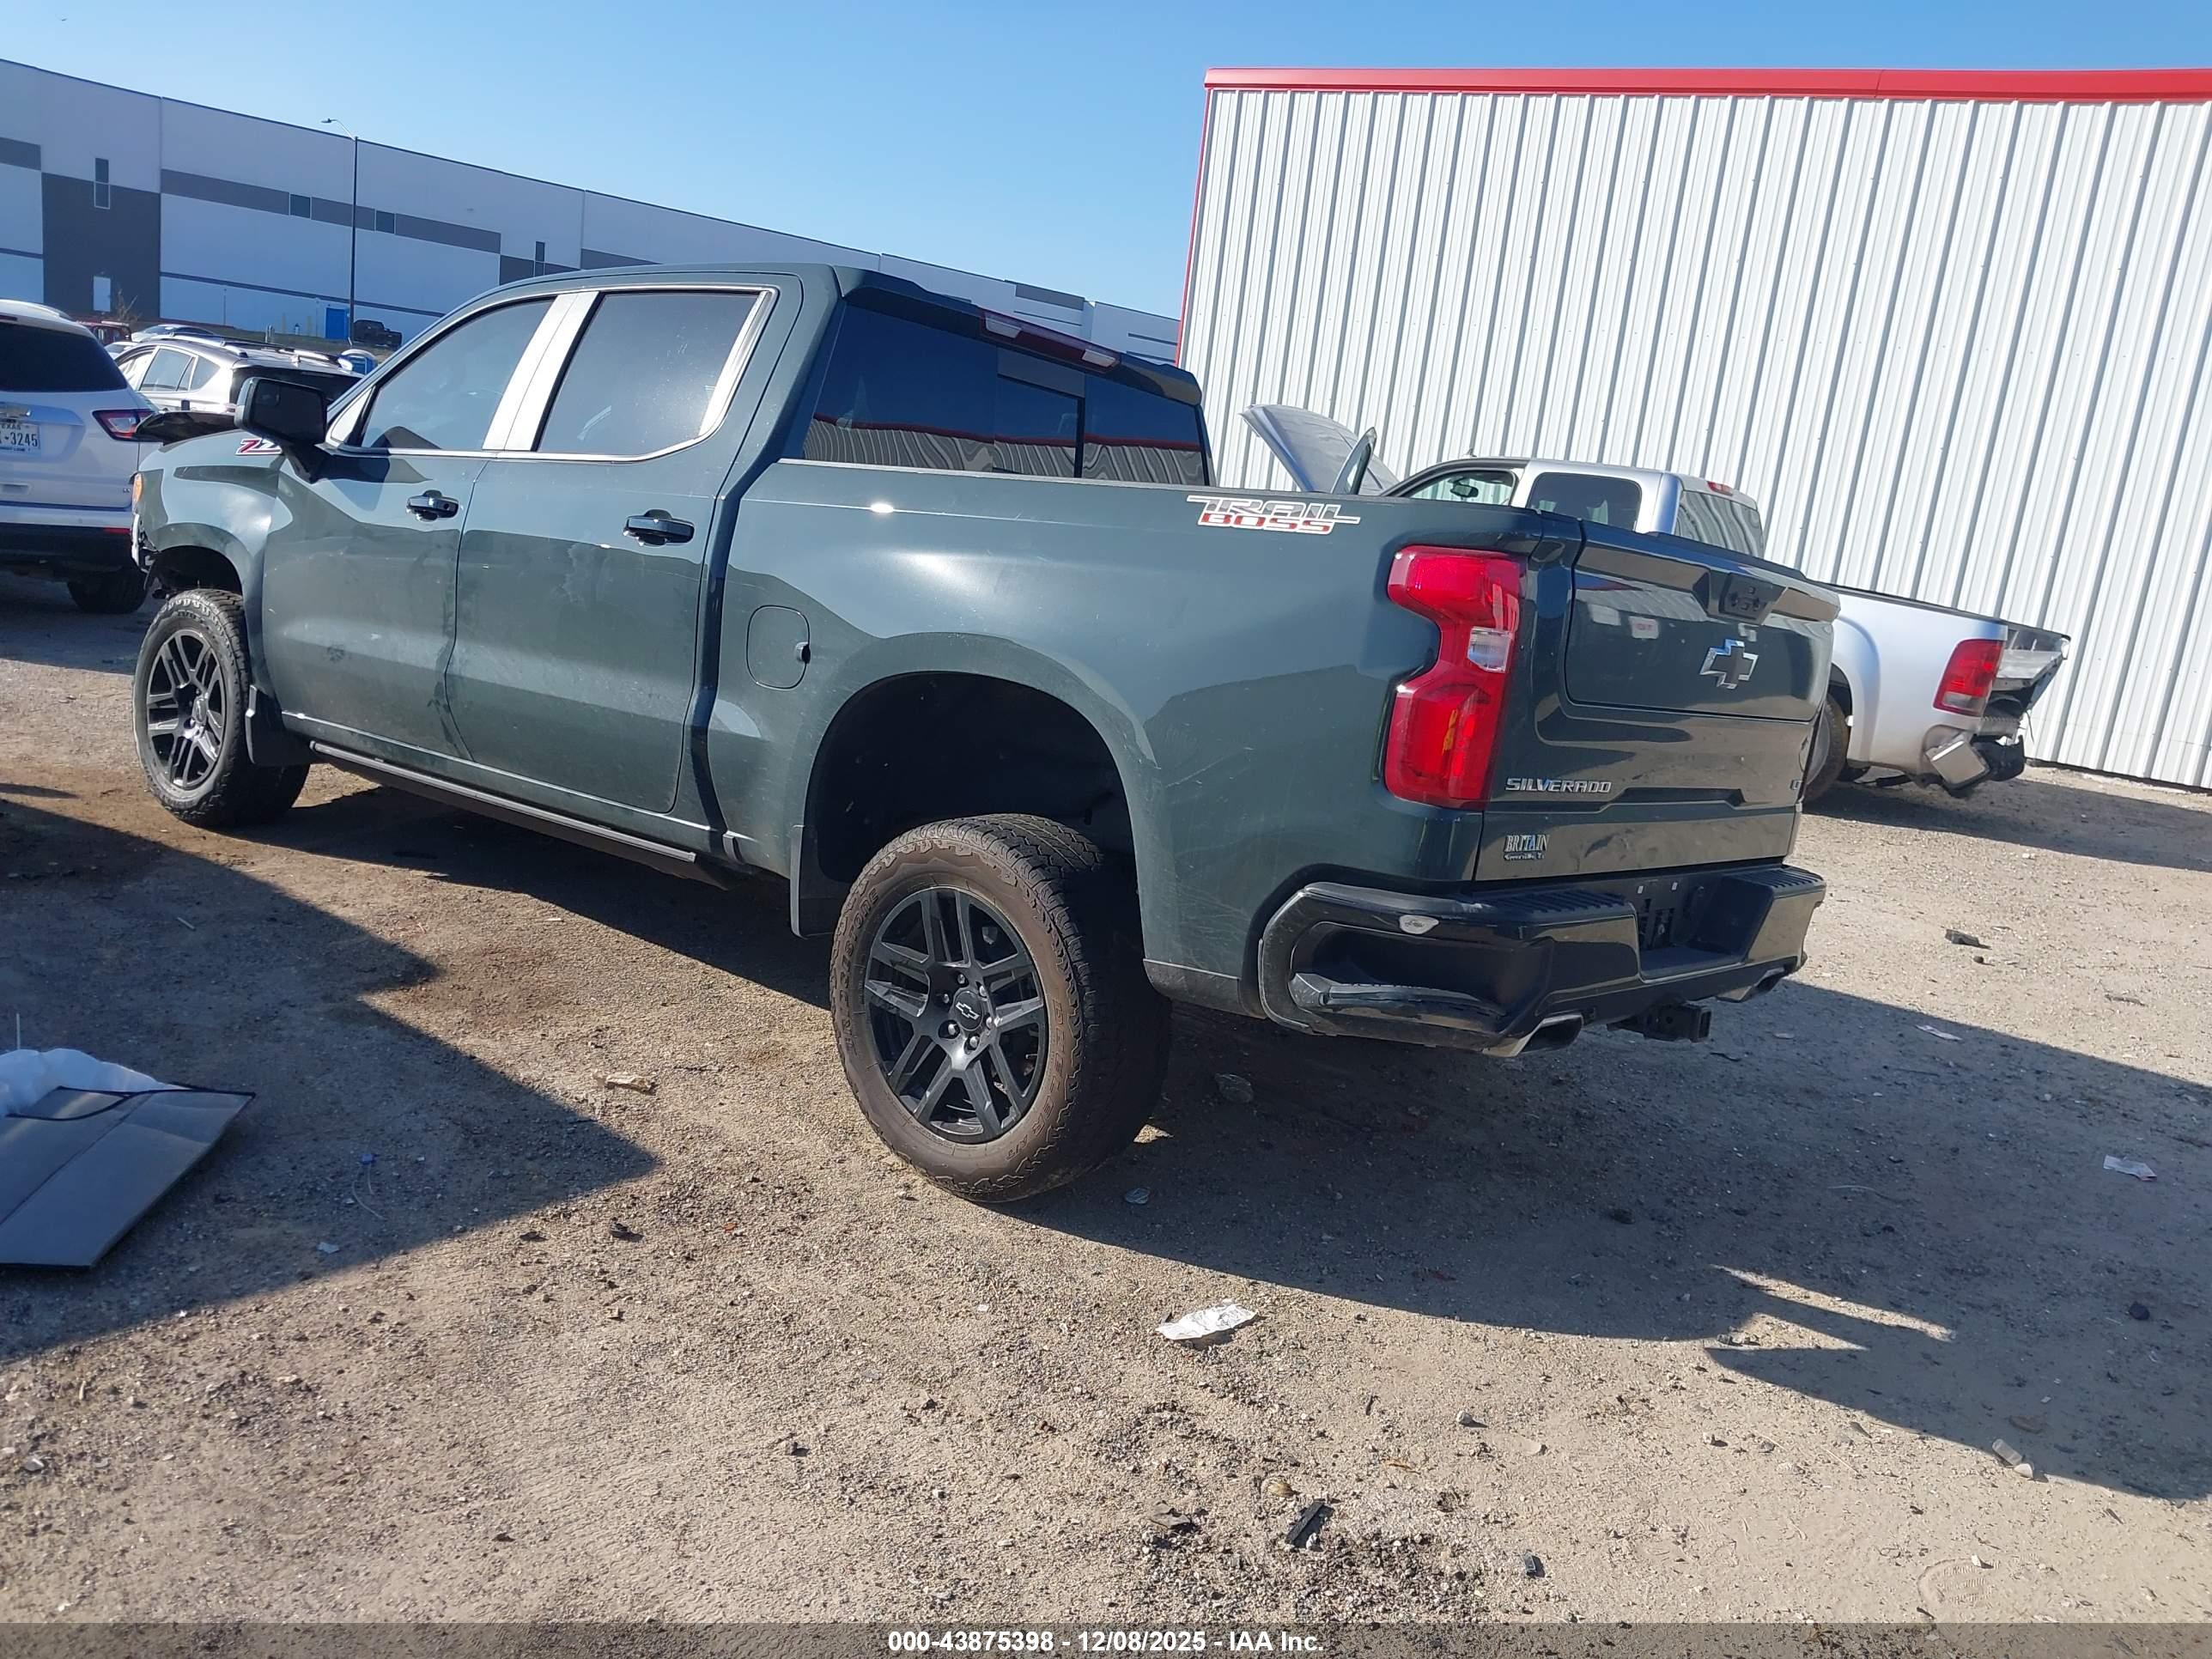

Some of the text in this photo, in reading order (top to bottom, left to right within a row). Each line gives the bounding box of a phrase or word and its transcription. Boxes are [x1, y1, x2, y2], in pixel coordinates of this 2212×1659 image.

[1187, 495, 1361, 524] TRAIL
[1199, 514, 1335, 534] BOSS
[1505, 777, 1612, 793] SILVERADO
[1504, 834, 1550, 852] BRITAIN
